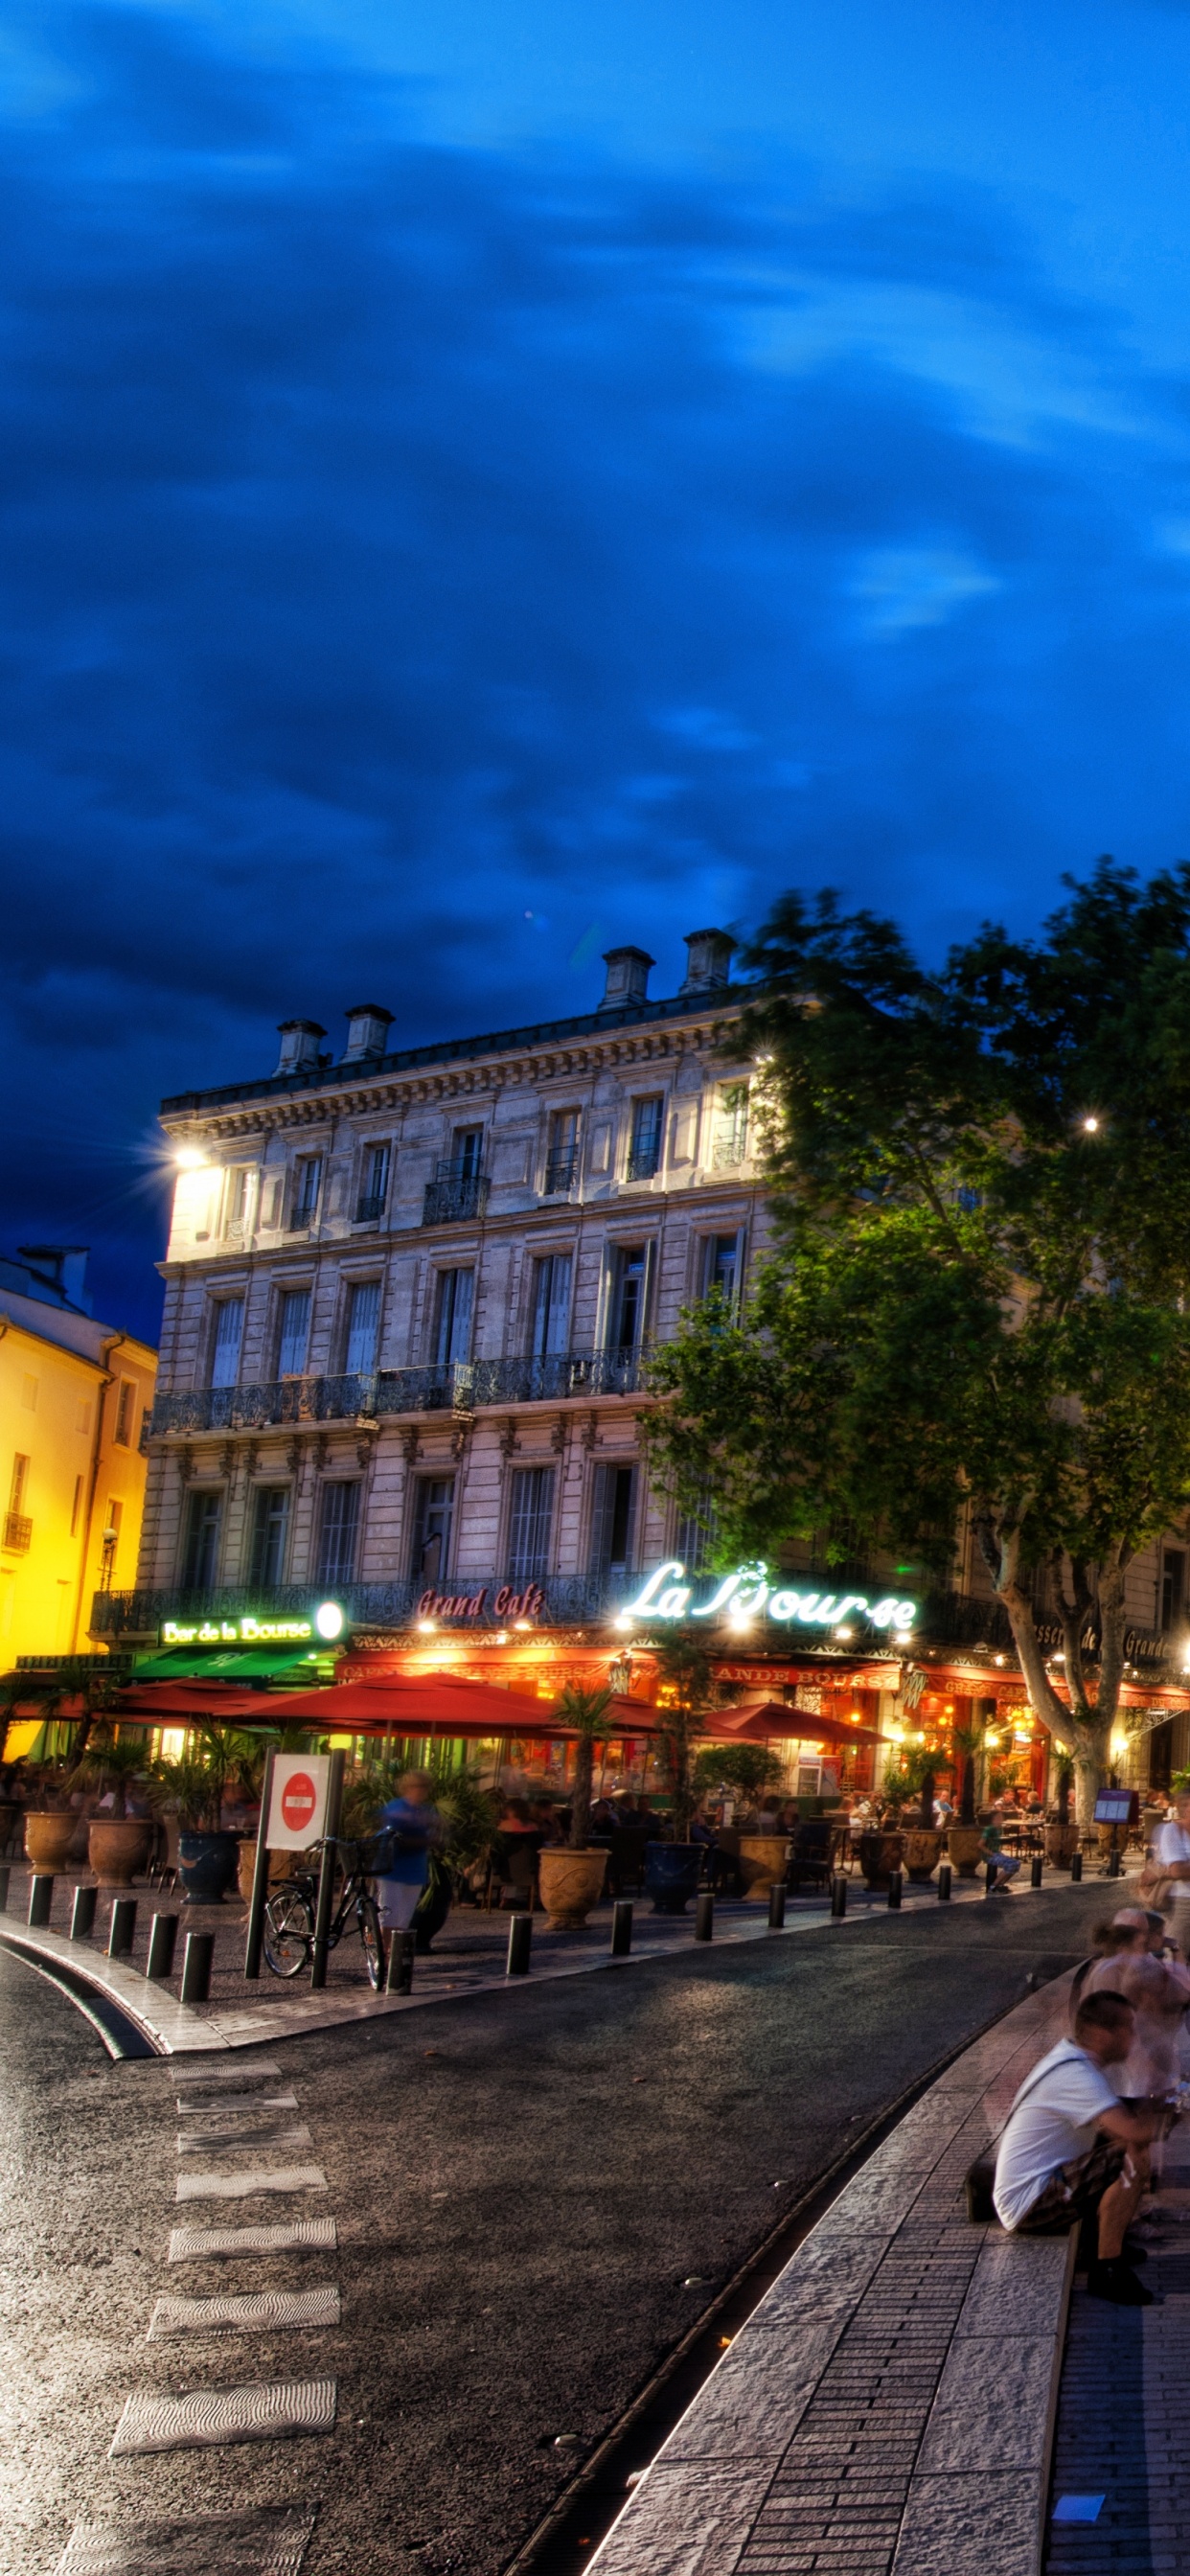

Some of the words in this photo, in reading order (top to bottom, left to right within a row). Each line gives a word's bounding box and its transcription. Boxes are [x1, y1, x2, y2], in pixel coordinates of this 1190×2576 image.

[417, 1587, 488, 1618] Grand
[493, 1582, 545, 1617] Café
[622, 1562, 692, 1618] La
[692, 1560, 917, 1629] Bourse
[164, 1622, 197, 1643] Bar
[198, 1622, 219, 1641] de
[221, 1622, 237, 1641] la
[240, 1618, 311, 1640] Bourse
[1081, 1626, 1098, 1650] de
[796, 1671, 900, 1689] BOURSE
